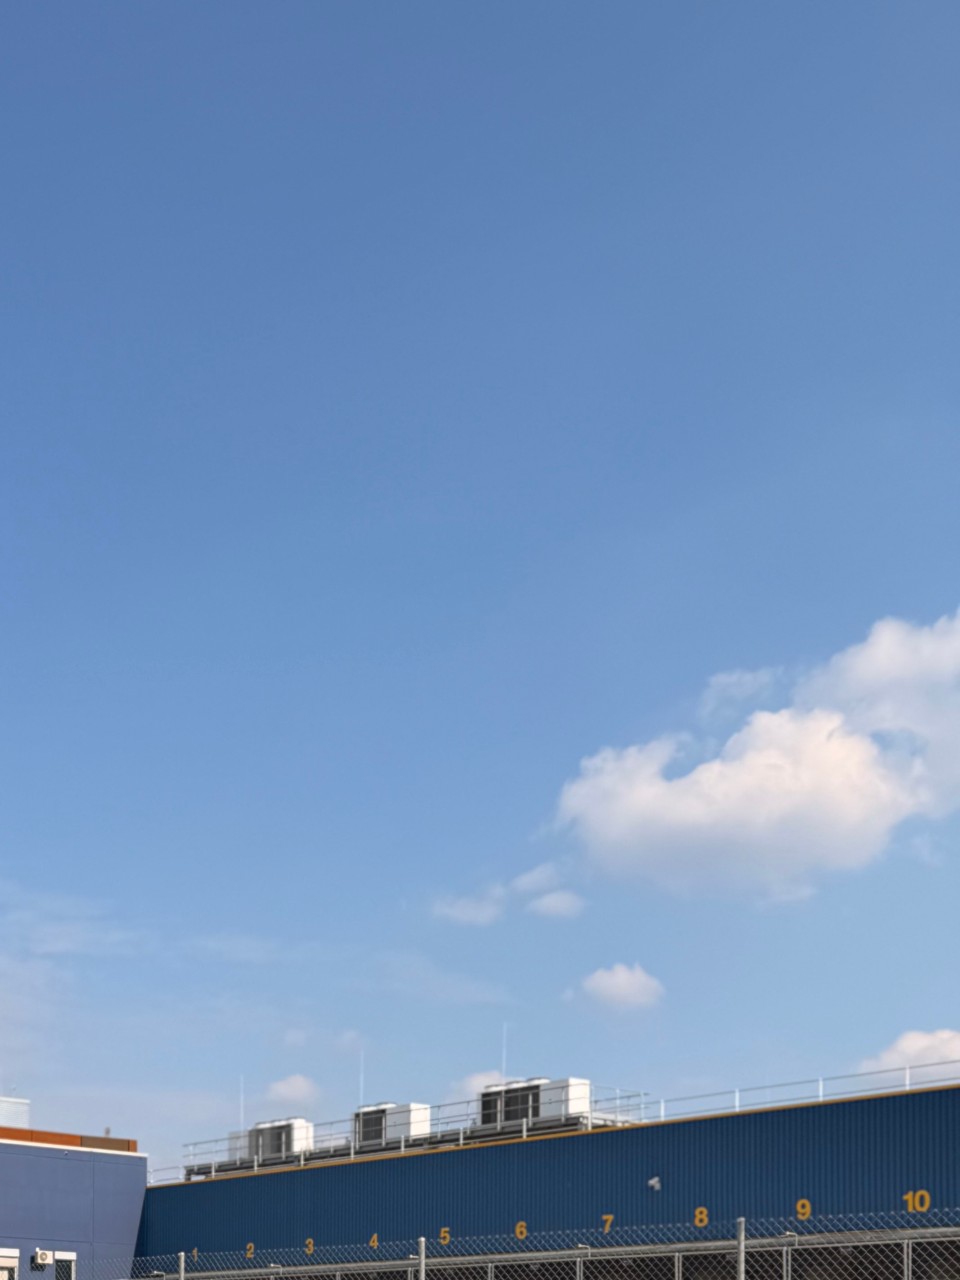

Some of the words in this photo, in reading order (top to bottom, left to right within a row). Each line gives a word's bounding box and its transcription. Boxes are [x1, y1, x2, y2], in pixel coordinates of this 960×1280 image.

[796, 1199, 811, 1220] 9
[903, 1190, 930, 1212] 10
[602, 1214, 614, 1233] 7
[694, 1207, 708, 1227] 8
[440, 1227, 450, 1245] 5
[515, 1221, 527, 1240] 6
[305, 1238, 314, 1255] 3
[369, 1233, 378, 1248] 4
[245, 1243, 255, 1258] 2
